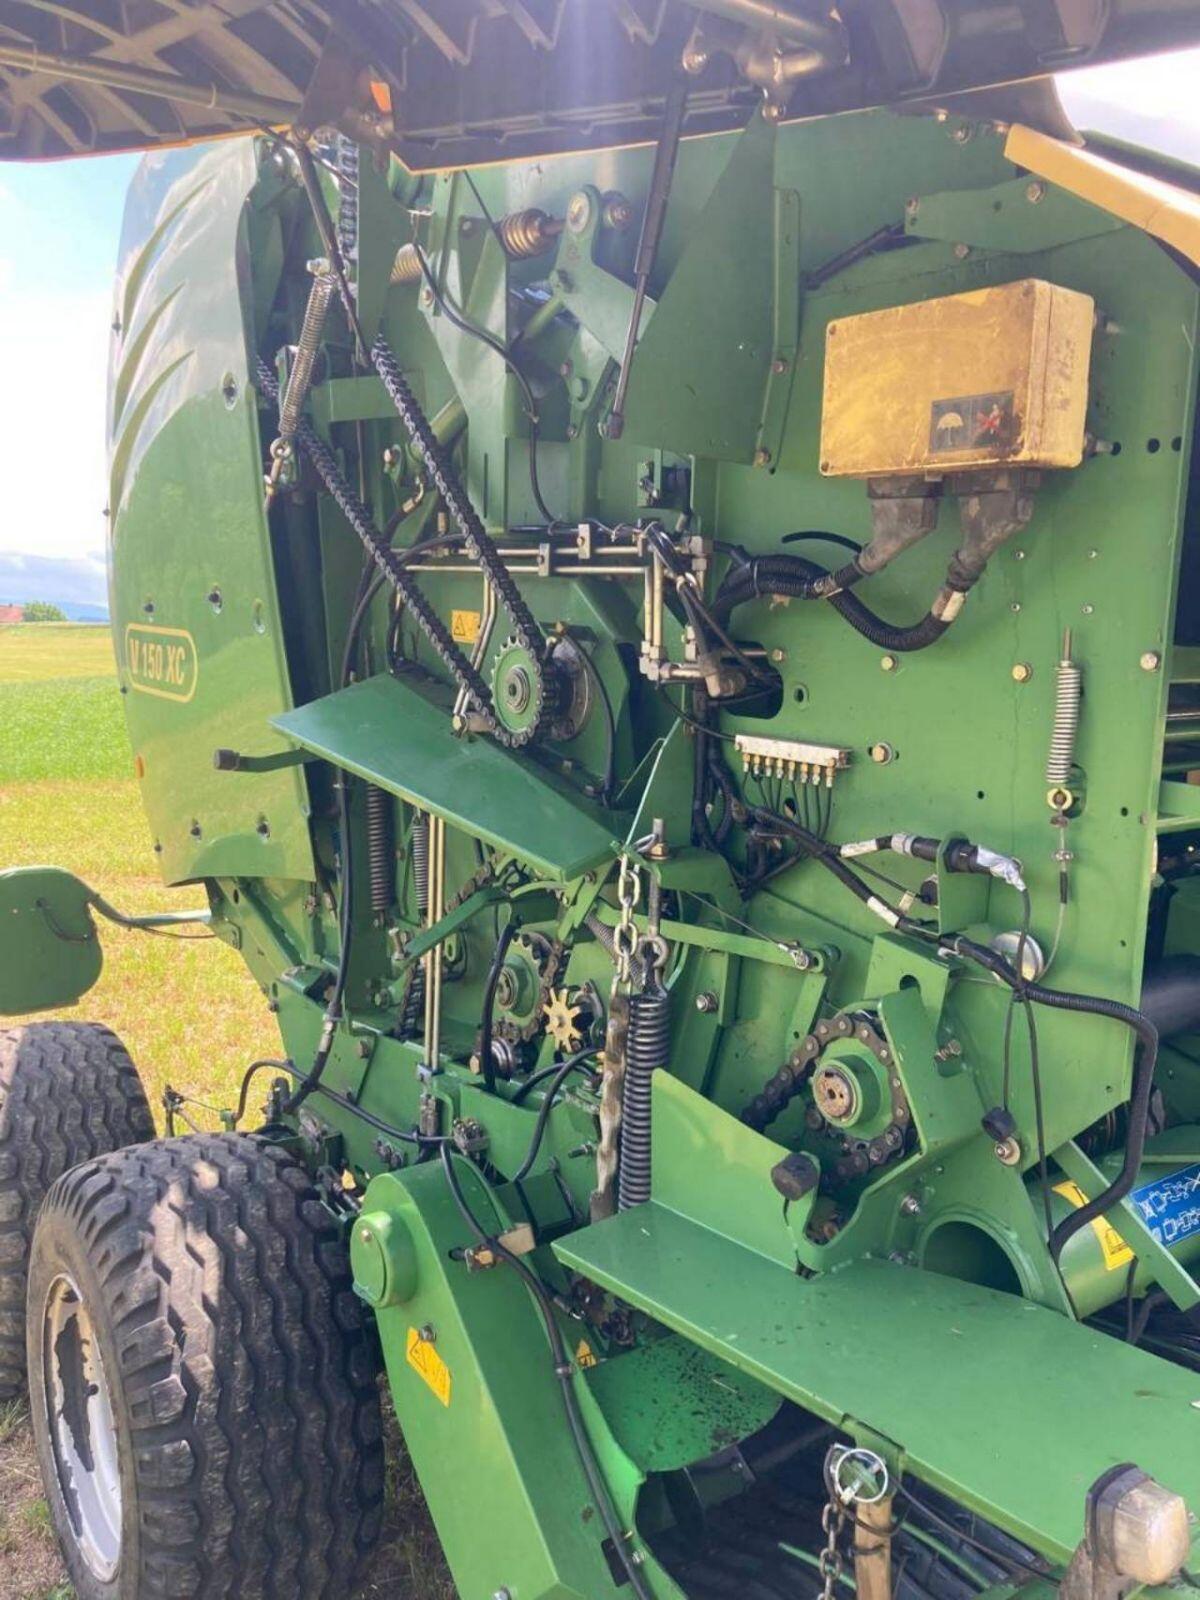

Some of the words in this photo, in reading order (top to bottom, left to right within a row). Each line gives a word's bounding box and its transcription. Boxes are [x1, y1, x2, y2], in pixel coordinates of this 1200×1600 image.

[130, 638, 139, 675] V
[142, 642, 163, 681] 150
[165, 645, 186, 685] XC
